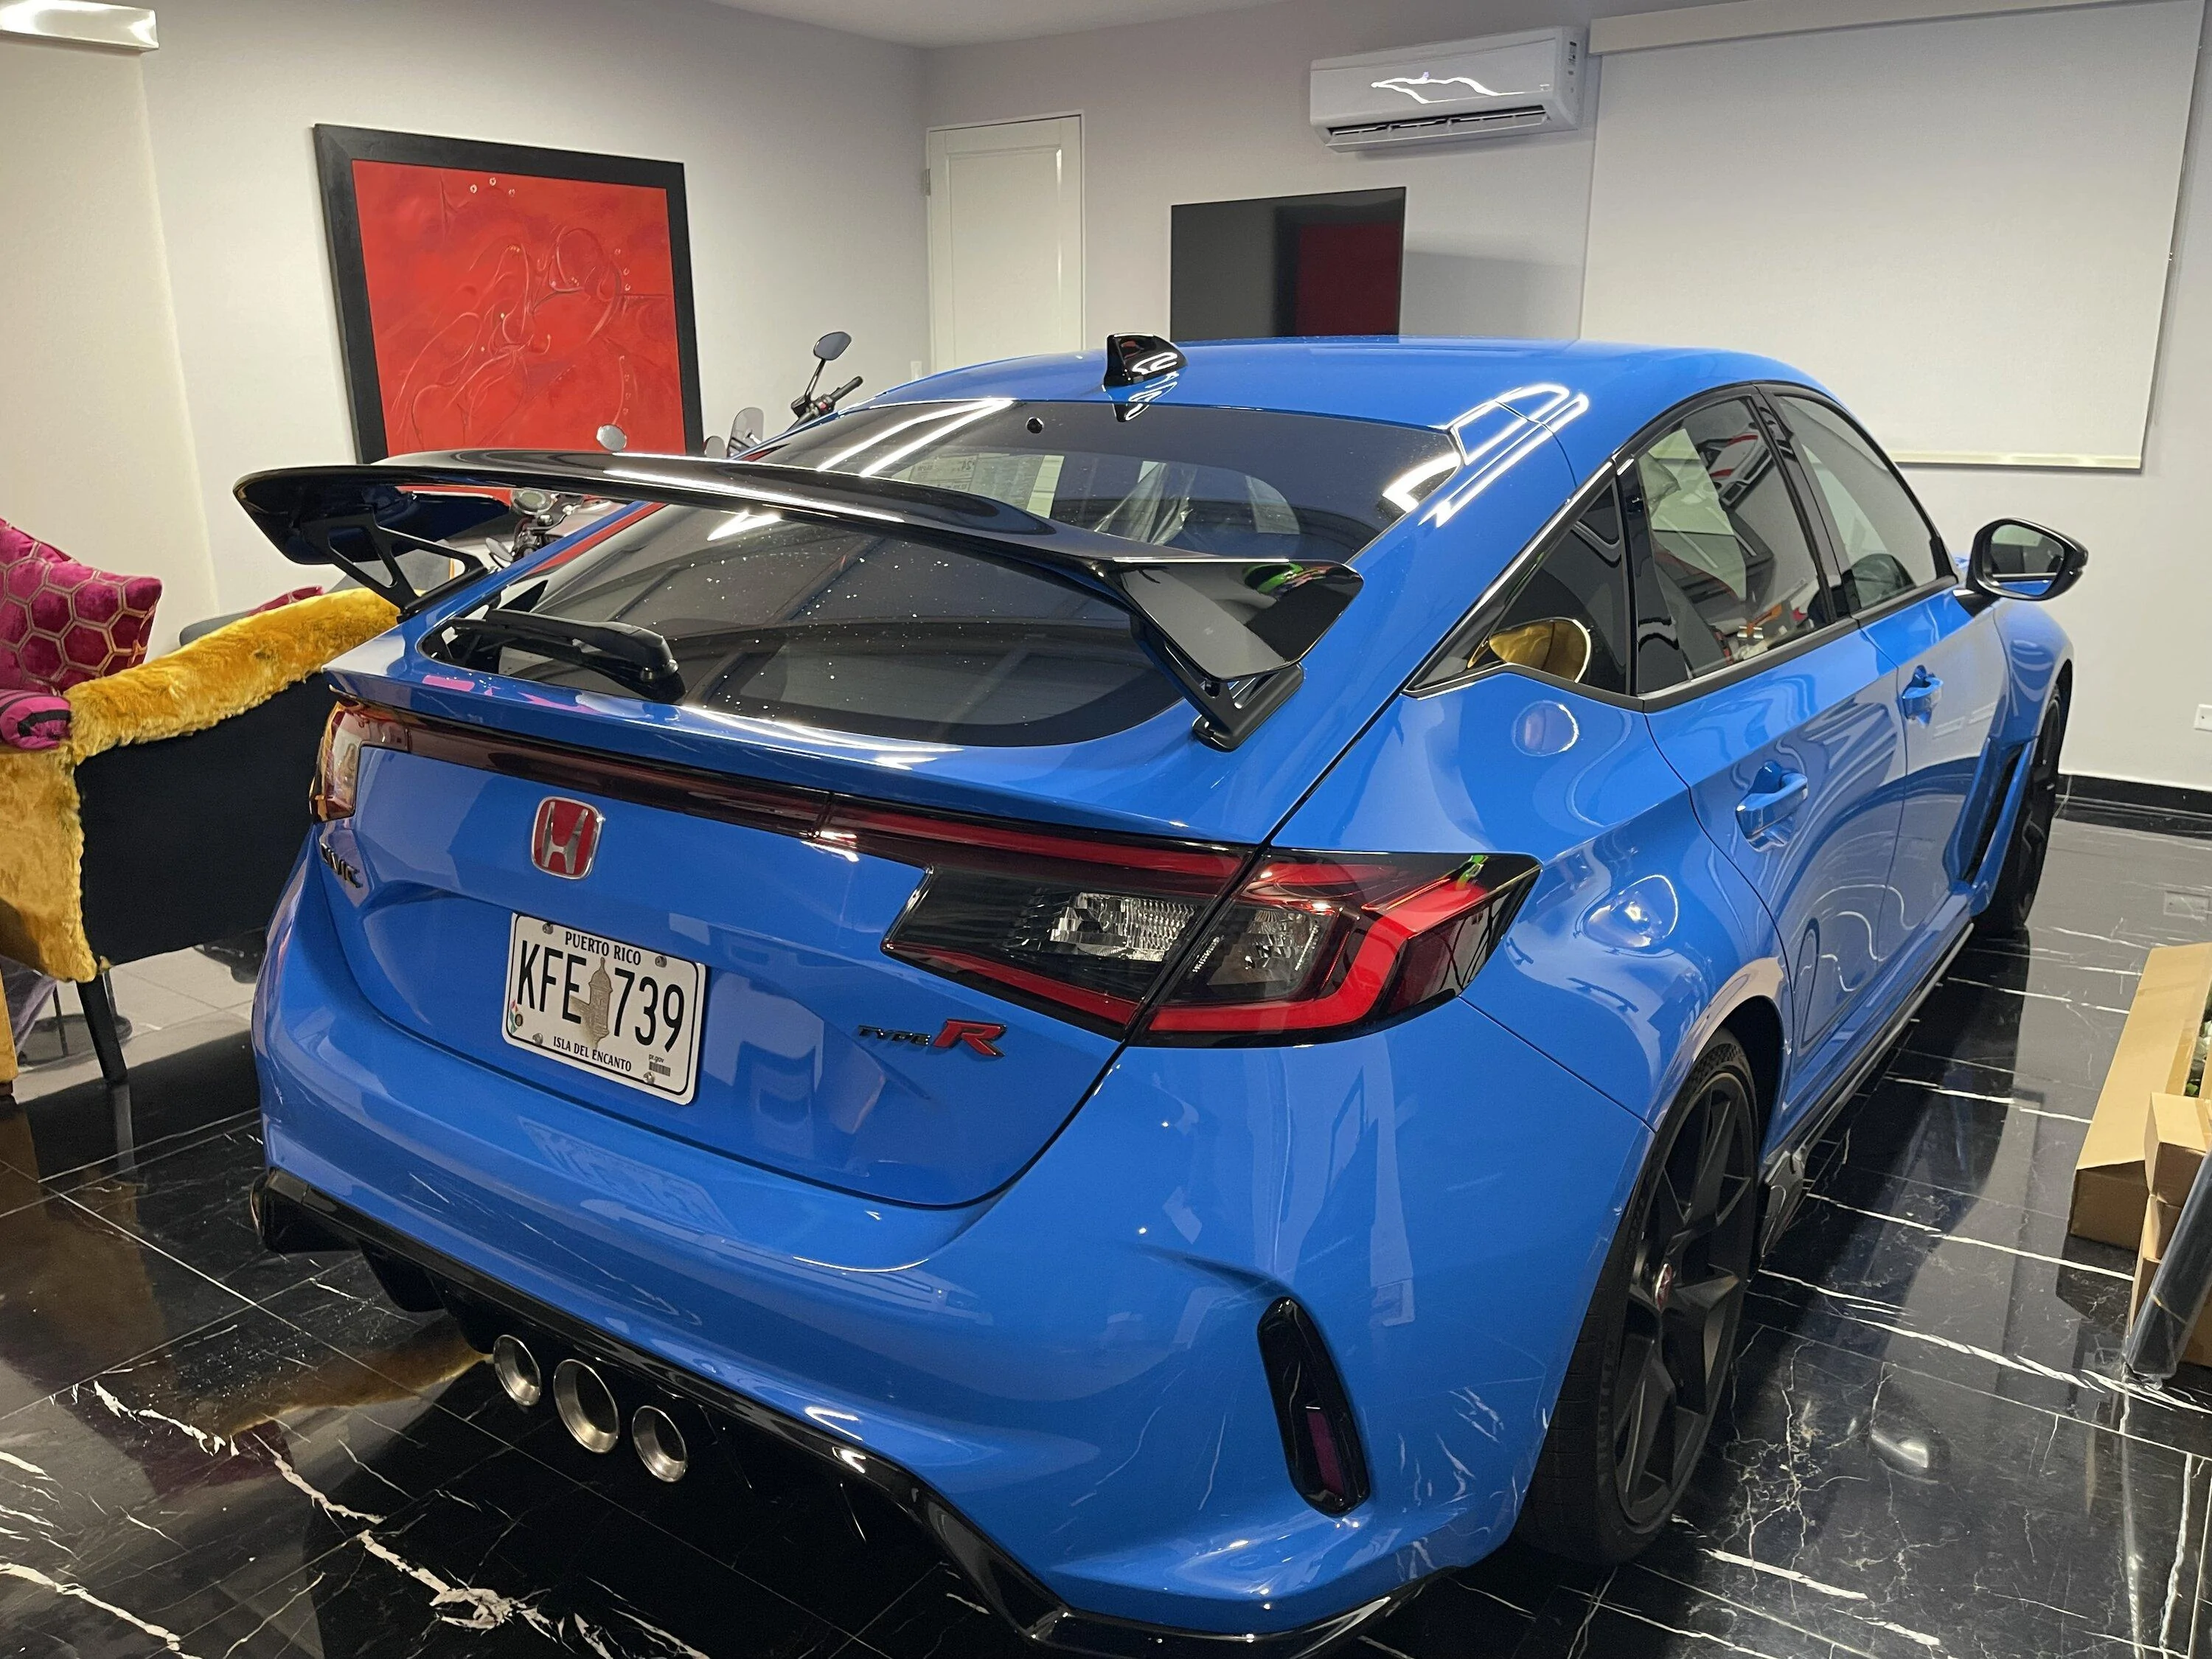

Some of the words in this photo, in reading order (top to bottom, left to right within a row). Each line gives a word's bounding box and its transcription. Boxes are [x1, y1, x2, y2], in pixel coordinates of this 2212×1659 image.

[565, 931, 609, 957] PUERTO
[613, 945, 641, 966] RICO
[517, 940, 587, 1024] KFE
[613, 967, 685, 1053] 739
[553, 1036, 571, 1053] ISLA
[574, 1045, 588, 1058] DEL
[591, 1049, 632, 1072] ENCANTO
[858, 1025, 932, 1046] TYPE
[932, 1018, 1007, 1057] R
